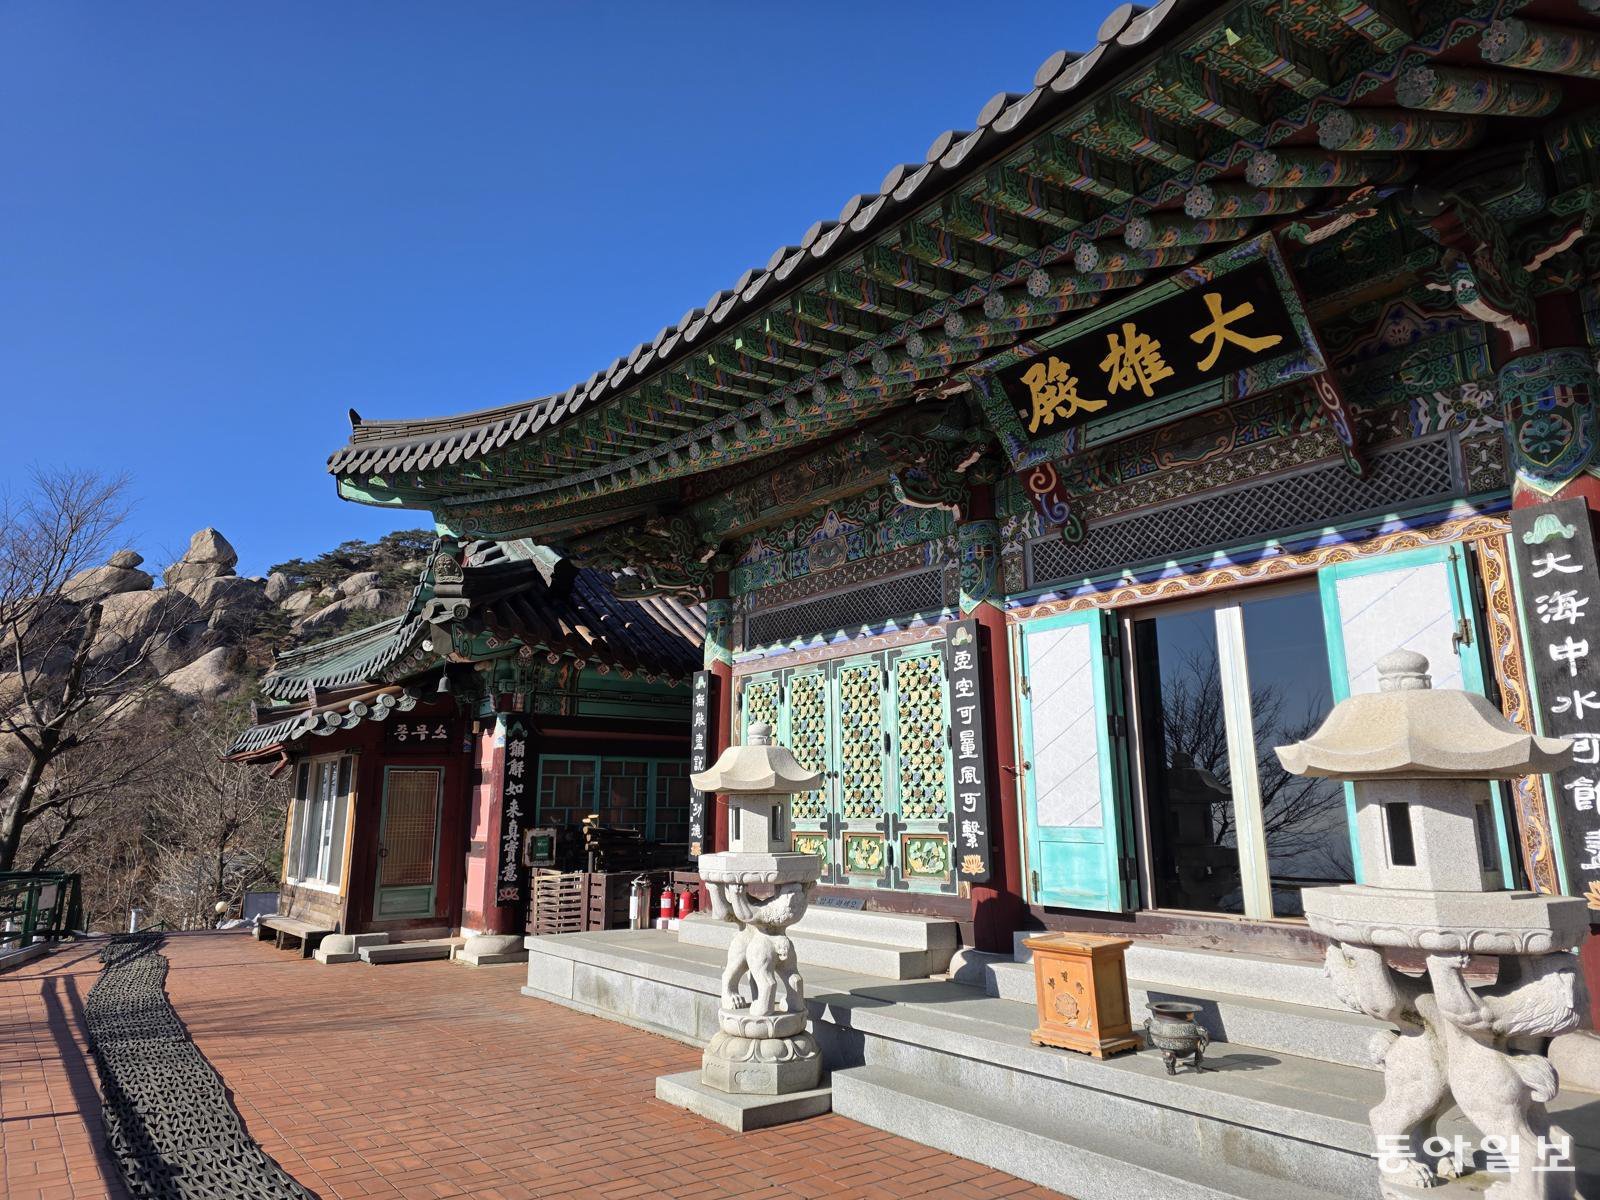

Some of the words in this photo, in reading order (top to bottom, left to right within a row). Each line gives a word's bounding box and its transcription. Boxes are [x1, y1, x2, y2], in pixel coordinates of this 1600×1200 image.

[1020, 293, 1283, 433] 大雄殿
[393, 724, 448, 741] 종무소
